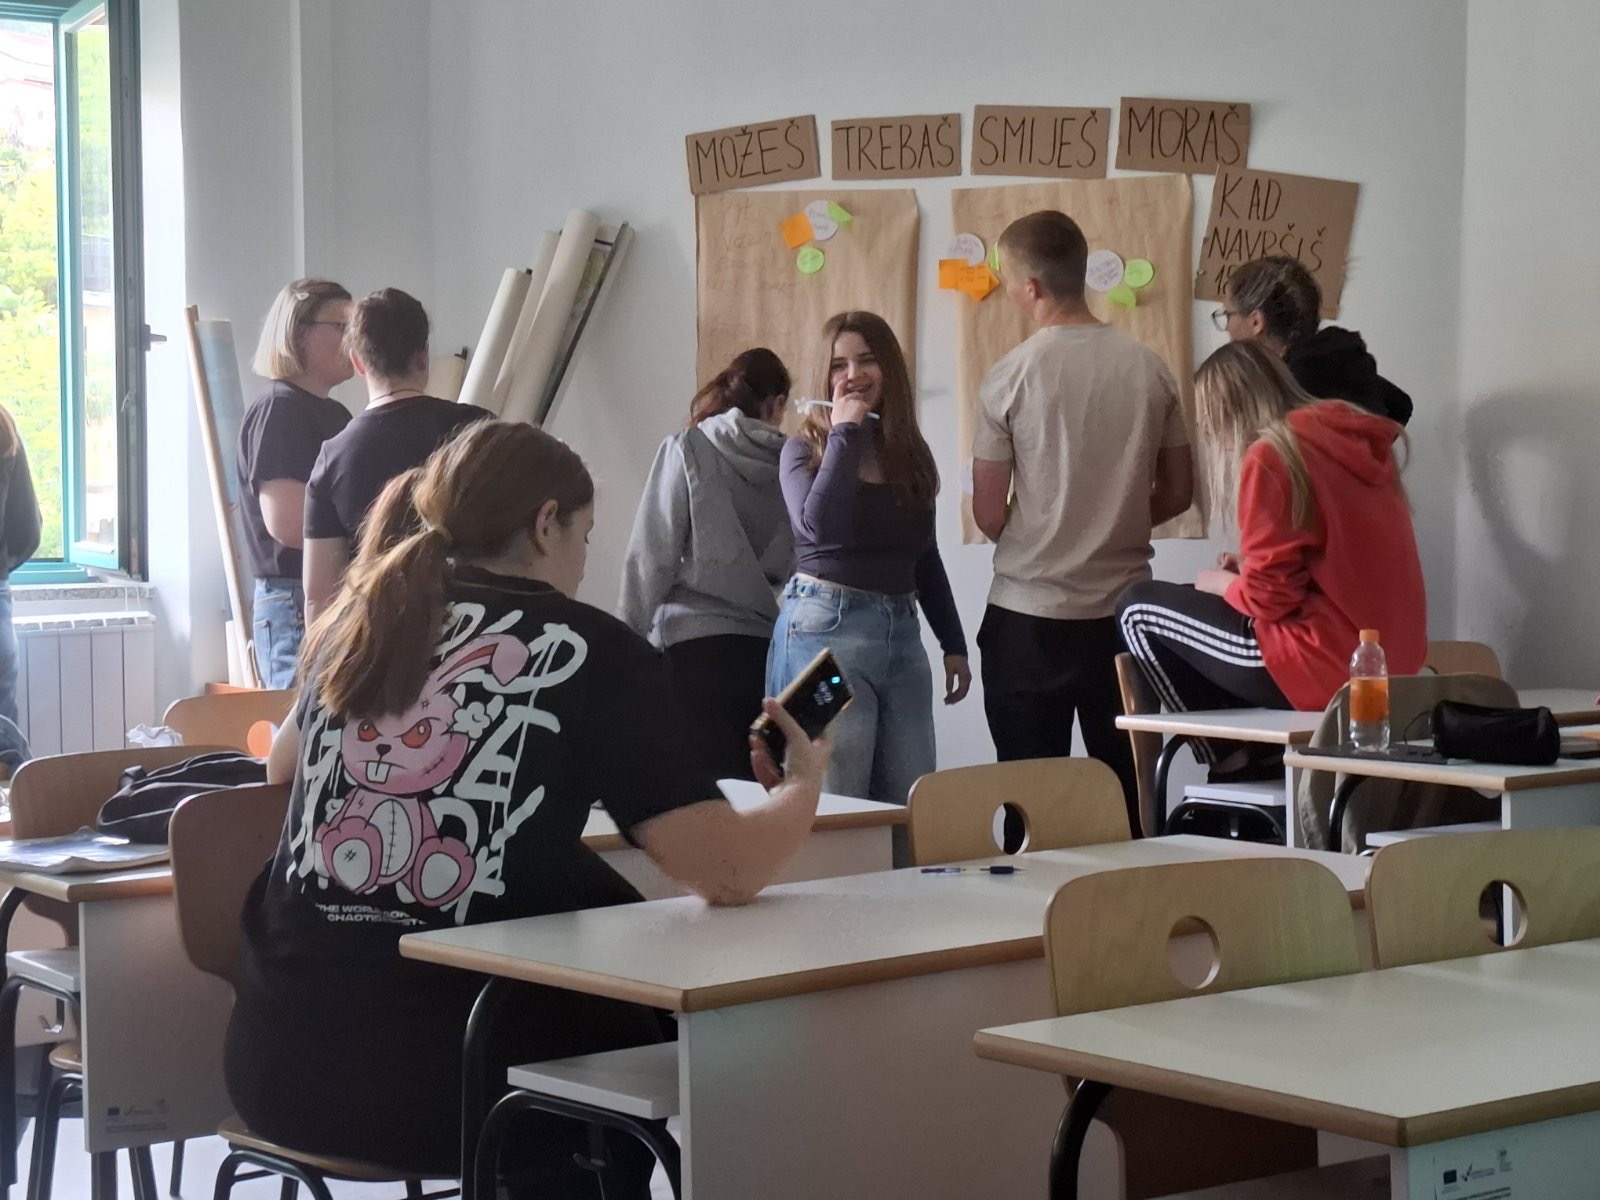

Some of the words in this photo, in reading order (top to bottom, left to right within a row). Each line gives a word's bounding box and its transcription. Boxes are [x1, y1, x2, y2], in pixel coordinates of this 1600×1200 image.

[695, 119, 805, 185] MOŽEŠ
[835, 116, 955, 172] TREBAŠ
[979, 109, 1098, 169] SMIJEŠ
[1127, 104, 1241, 165] MORAŠ
[1219, 172, 1282, 221] KAD
